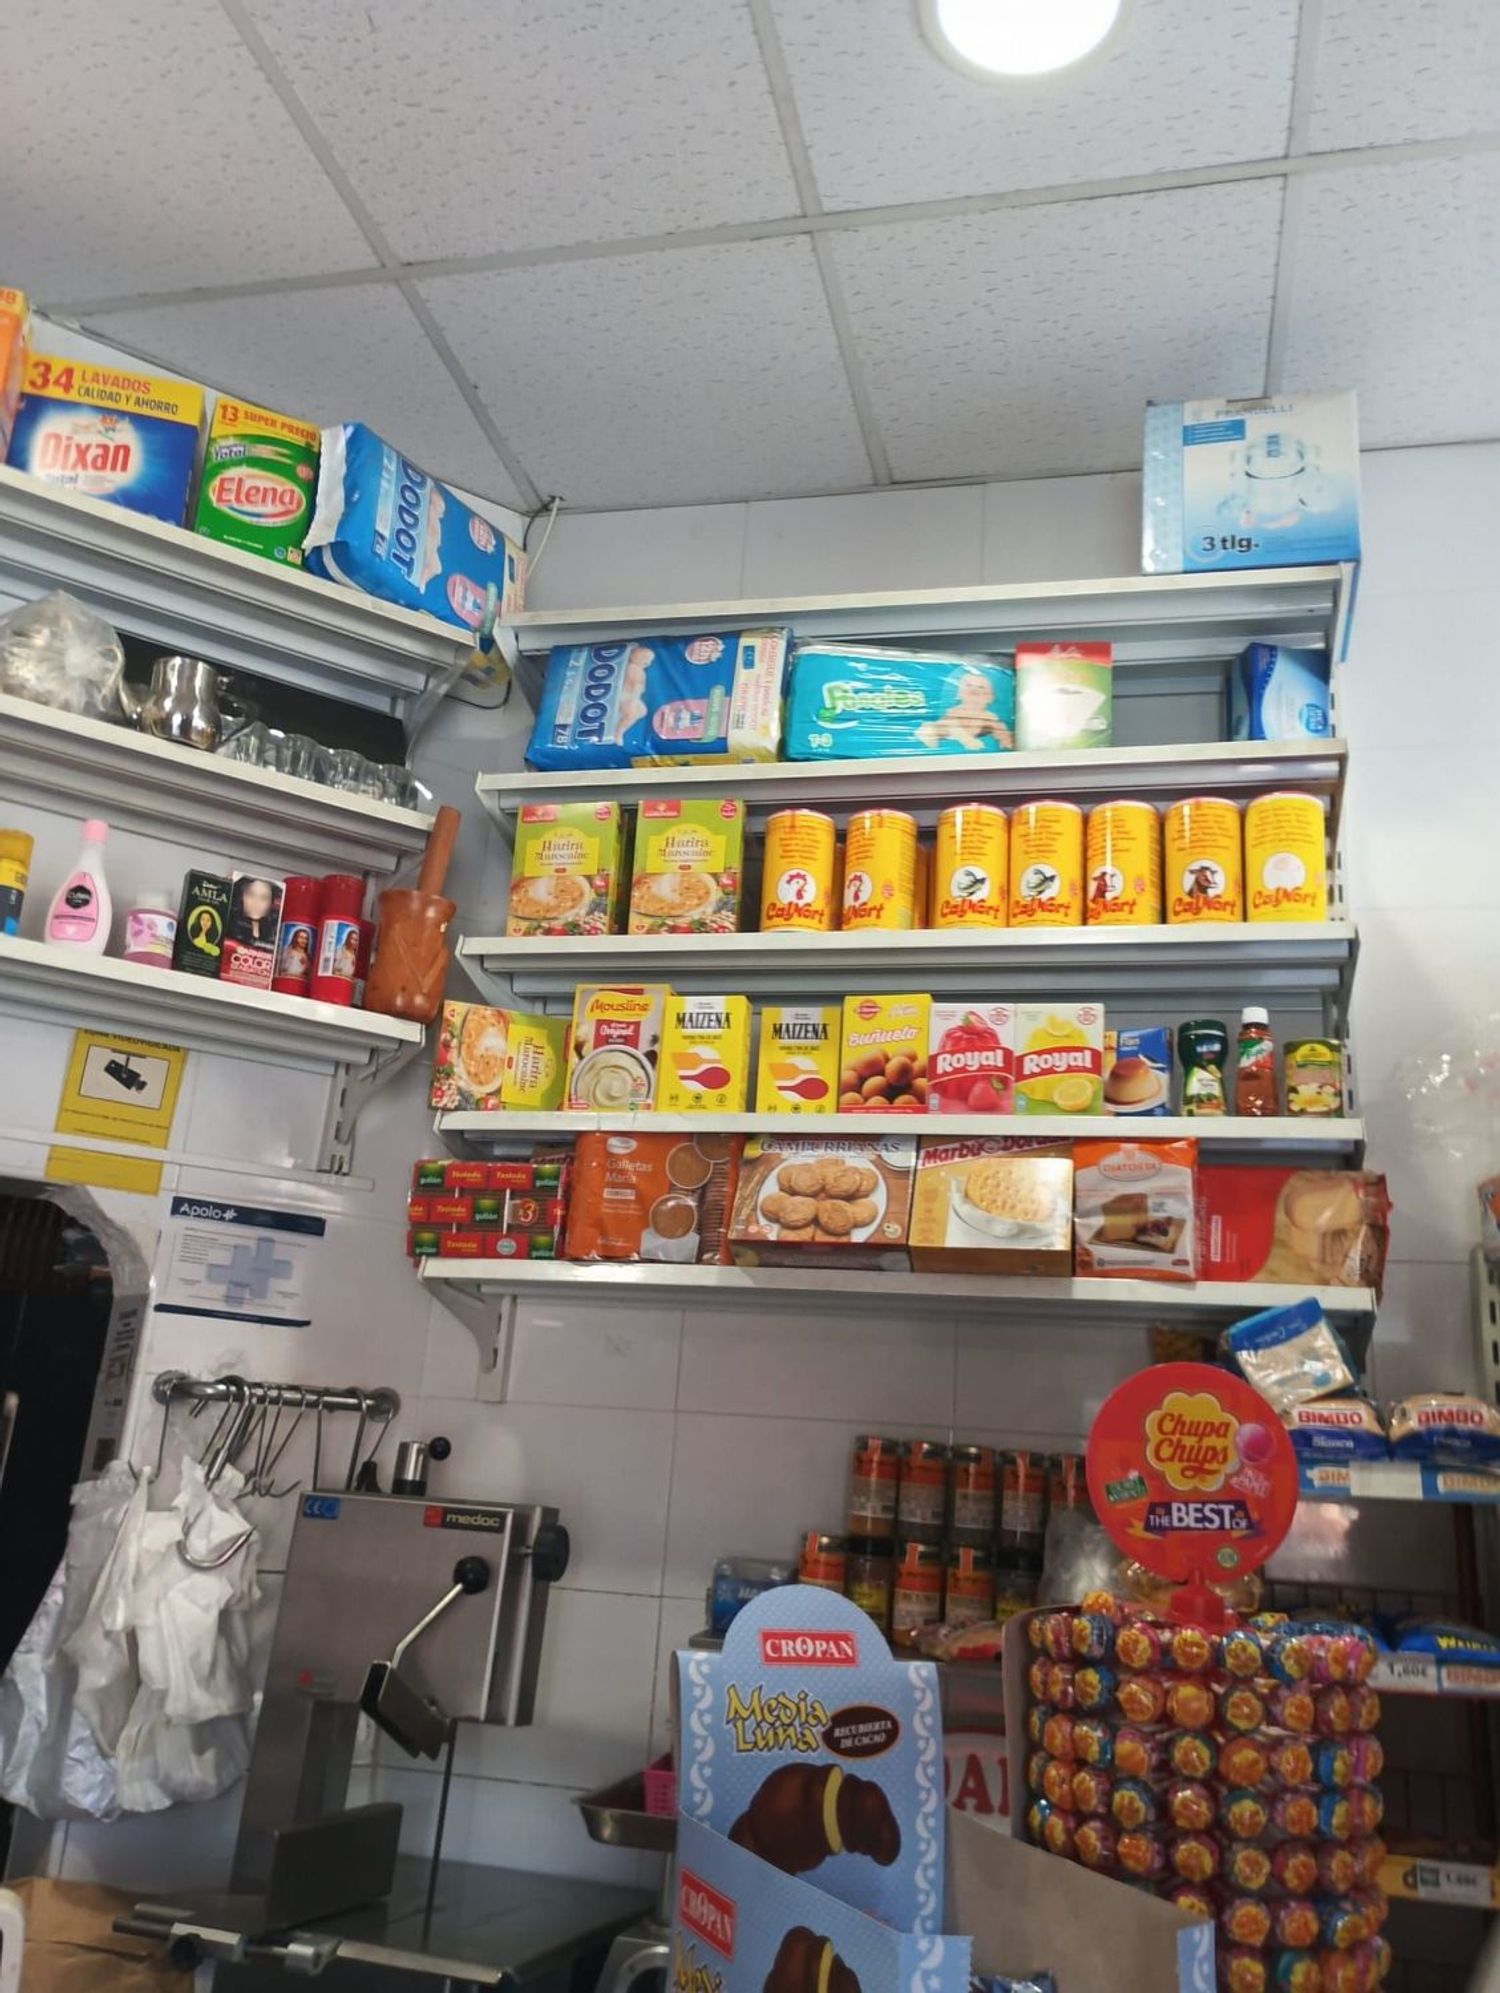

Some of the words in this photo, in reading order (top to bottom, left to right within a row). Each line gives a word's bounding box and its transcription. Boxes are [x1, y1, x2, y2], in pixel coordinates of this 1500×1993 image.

[28, 361, 75, 394] 34
[81, 370, 151, 394] LAVADOS
[77, 385, 122, 404] CALIDAD
[125, 395, 132, 407] Y
[134, 396, 179, 415] AHORRO
[219, 404, 239, 423] 13
[243, 410, 278, 428] SUPER
[280, 421, 316, 441] PRECIO
[39, 432, 131, 472] Dixan
[214, 476, 296, 507] Elena
[391, 457, 427, 579] DODOT
[1201, 536, 1216, 552] 3
[1220, 534, 1260, 553] tlg.
[576, 644, 627, 743] DODOT
[192, 886, 228, 903] AMLA
[231, 953, 272, 970] COLOR
[675, 1012, 731, 1030] MAIZENA
[771, 1023, 830, 1040] MAIZENA
[936, 1050, 1004, 1075] Royal
[1023, 1050, 1092, 1075] Royal
[1156, 1412, 1232, 1442] Chupa
[1298, 1411, 1363, 1426] BIMBO
[1417, 1410, 1484, 1426] BIMBO
[1154, 1437, 1229, 1467] Chups
[1318, 1469, 1350, 1485] BIM
[1149, 1514, 1172, 1528] THE
[1171, 1502, 1234, 1529] BEST
[1232, 1518, 1249, 1529] OF
[765, 1635, 853, 1659] CROPAN
[726, 1683, 830, 1728] Media
[735, 1718, 820, 1753] Luna
[833, 1720, 893, 1738] RECUBIERTA
[840, 1737, 852, 1749] DE
[854, 1733, 886, 1747] CACAO
[682, 1885, 732, 1943] CROPAN
